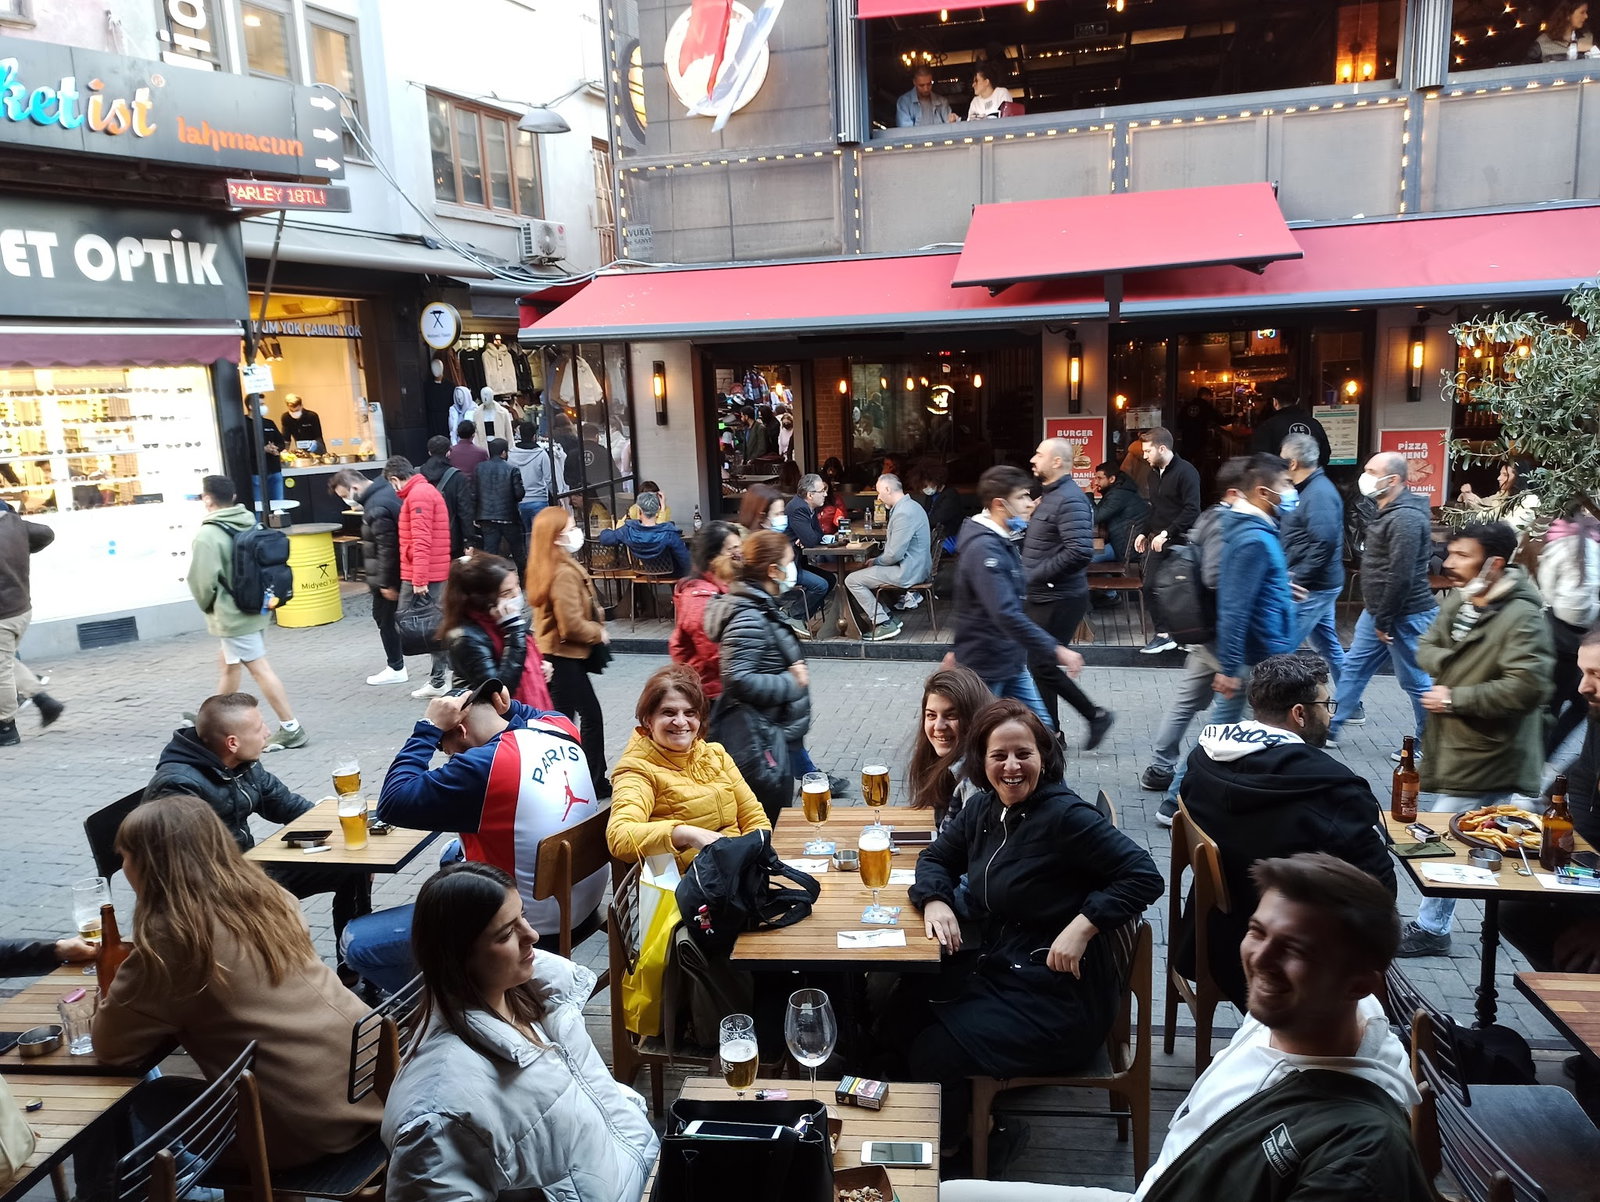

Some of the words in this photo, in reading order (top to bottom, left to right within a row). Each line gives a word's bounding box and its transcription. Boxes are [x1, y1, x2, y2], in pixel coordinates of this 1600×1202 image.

[176, 115, 304, 157] lahmacun
[74, 228, 224, 286] OPTİK
[1398, 441, 1428, 450] PİZZA
[1410, 484, 1436, 492] DAHİL
[532, 746, 579, 785] PARIS
